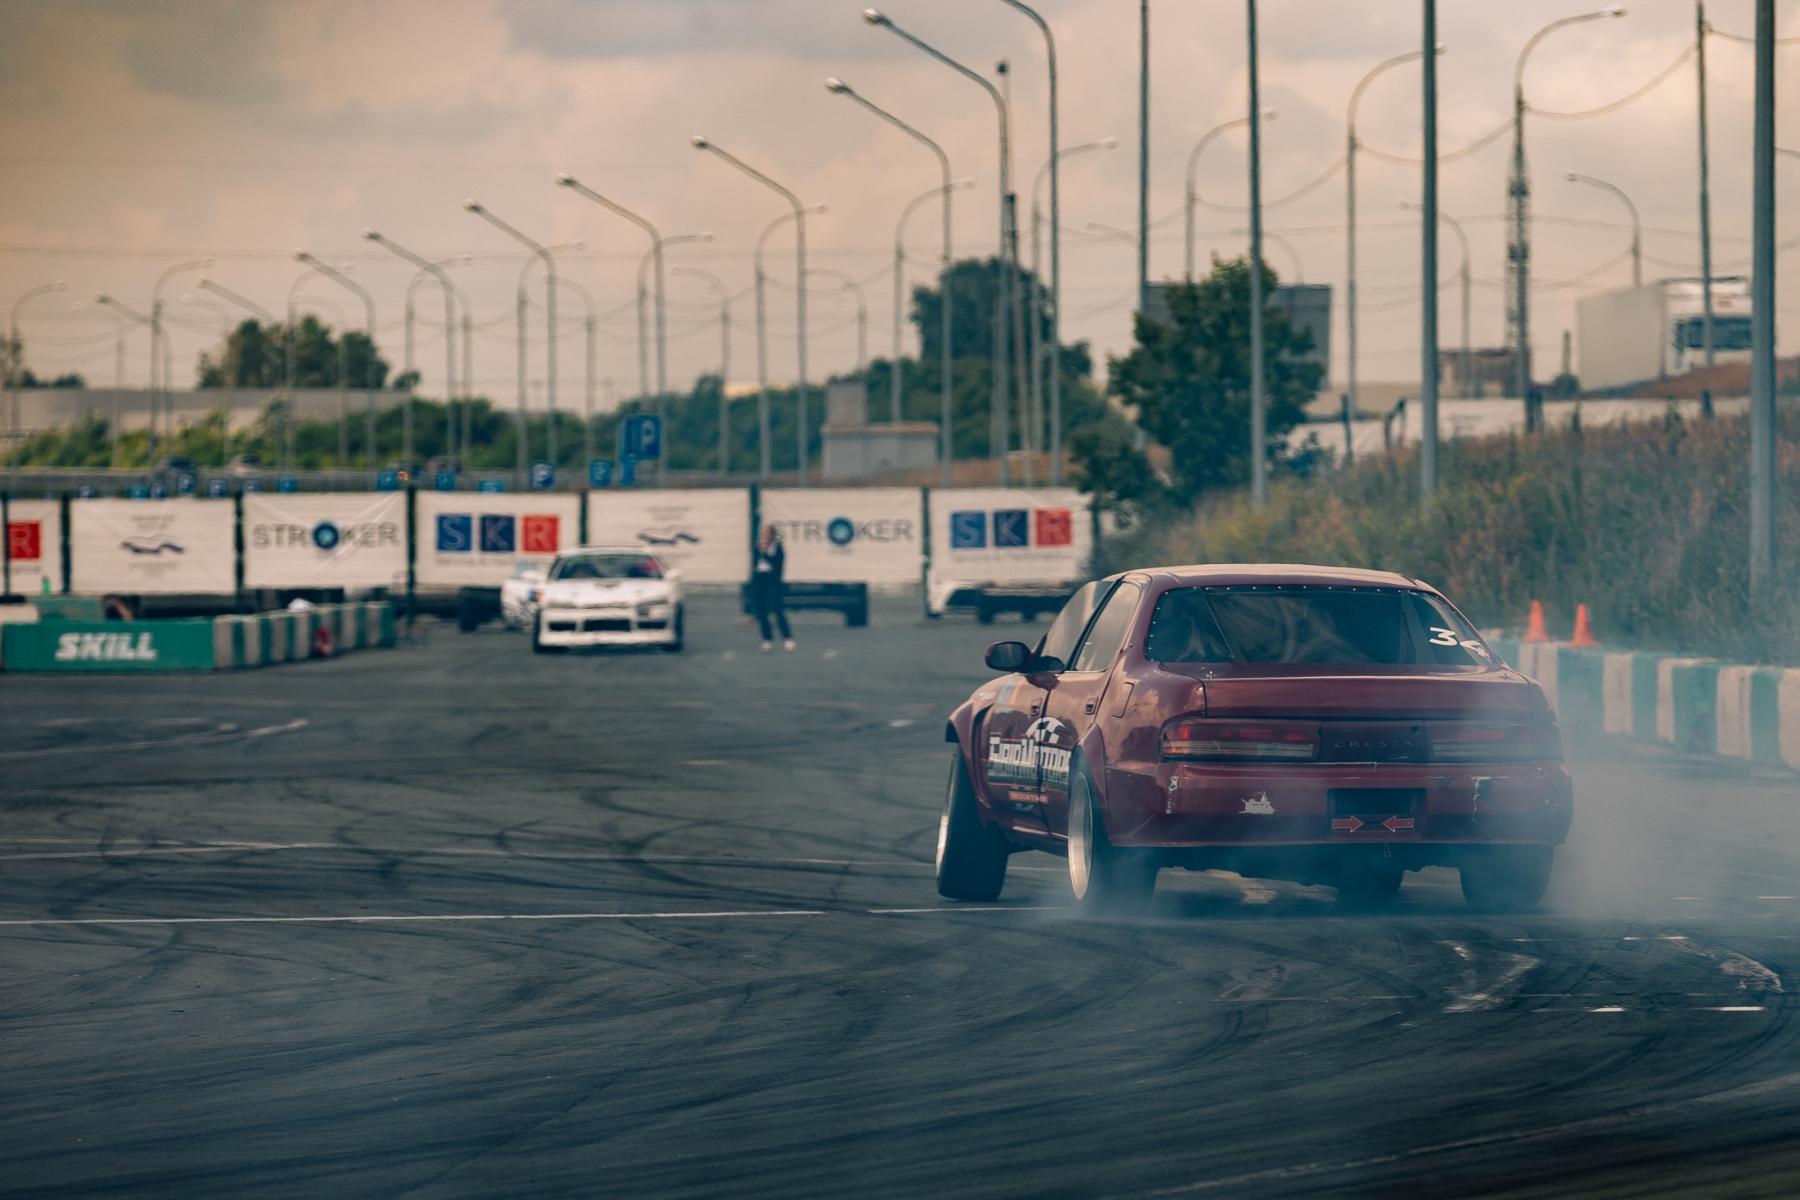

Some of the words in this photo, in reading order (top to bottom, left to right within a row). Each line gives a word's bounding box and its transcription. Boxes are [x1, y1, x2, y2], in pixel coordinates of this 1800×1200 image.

[641, 420, 655, 449] P
[253, 522, 399, 550] STROKER
[442, 517, 552, 550] SKR
[774, 518, 913, 544] STROKER
[958, 515, 1066, 547] SKR
[55, 632, 157, 661] SKILL
